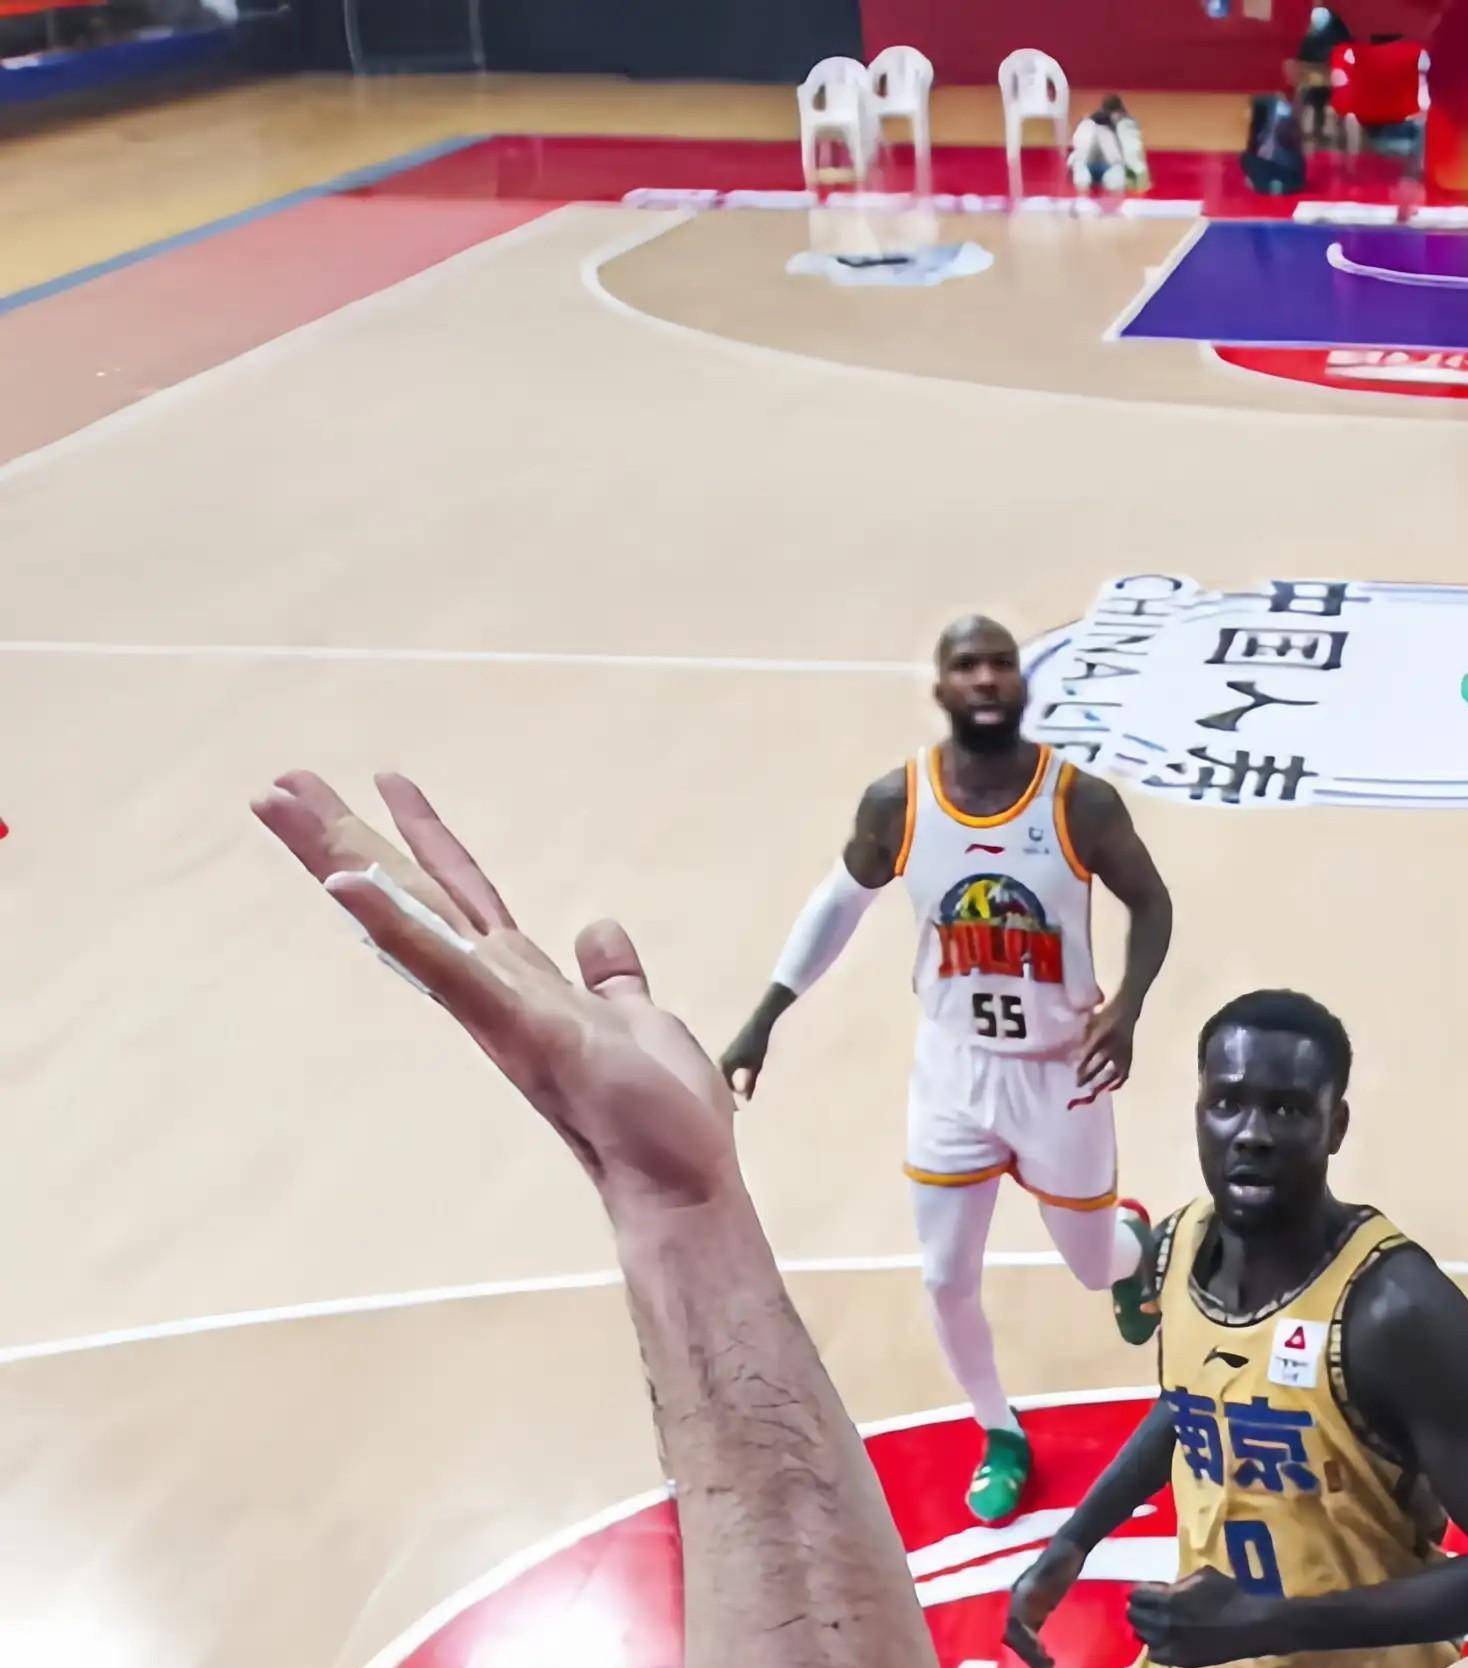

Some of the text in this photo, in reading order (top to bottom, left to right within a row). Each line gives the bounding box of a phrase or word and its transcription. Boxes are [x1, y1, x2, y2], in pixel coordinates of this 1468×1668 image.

[1062, 574, 1183, 682] CHINA
[972, 993, 1027, 1038] 55
[1163, 1385, 1319, 1492] 南京
[1224, 1519, 1284, 1598] 0
